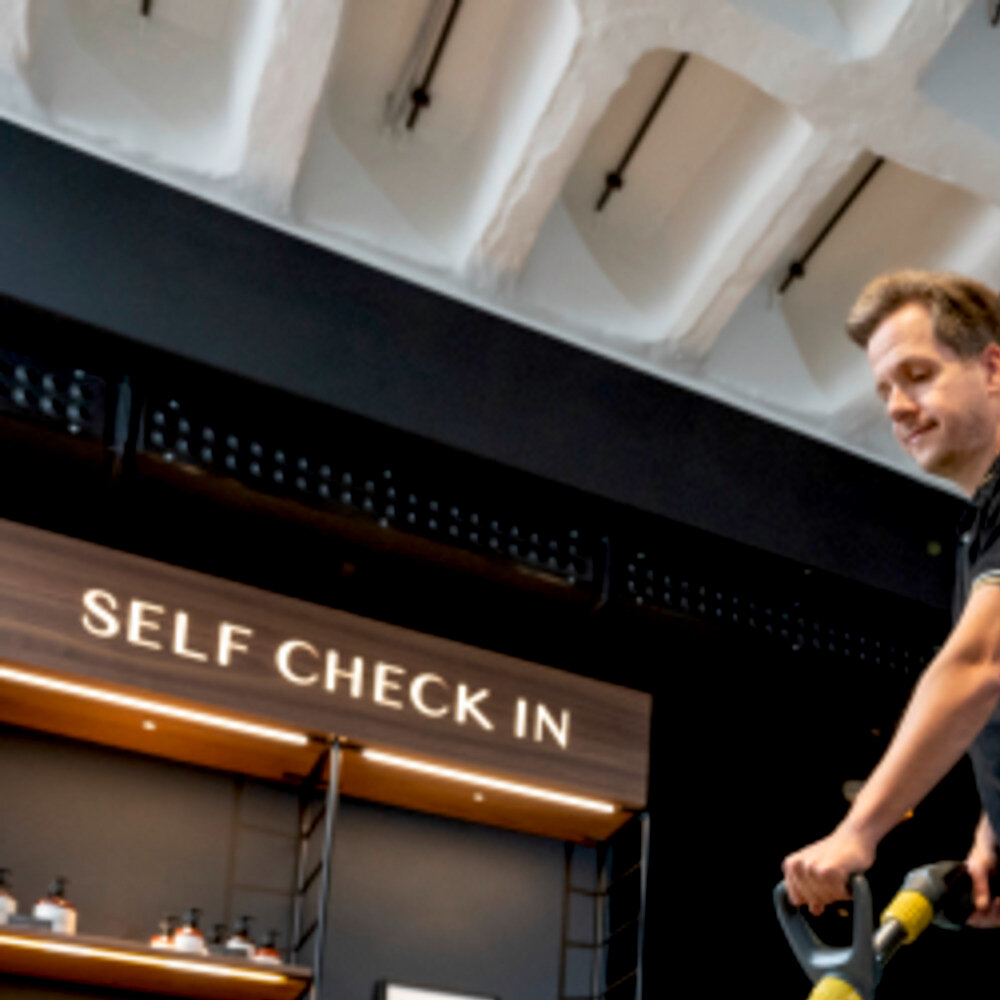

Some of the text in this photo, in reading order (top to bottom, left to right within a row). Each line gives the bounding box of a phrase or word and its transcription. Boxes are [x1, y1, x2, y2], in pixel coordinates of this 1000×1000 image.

[81, 589, 571, 749] SELF CHECK IN
